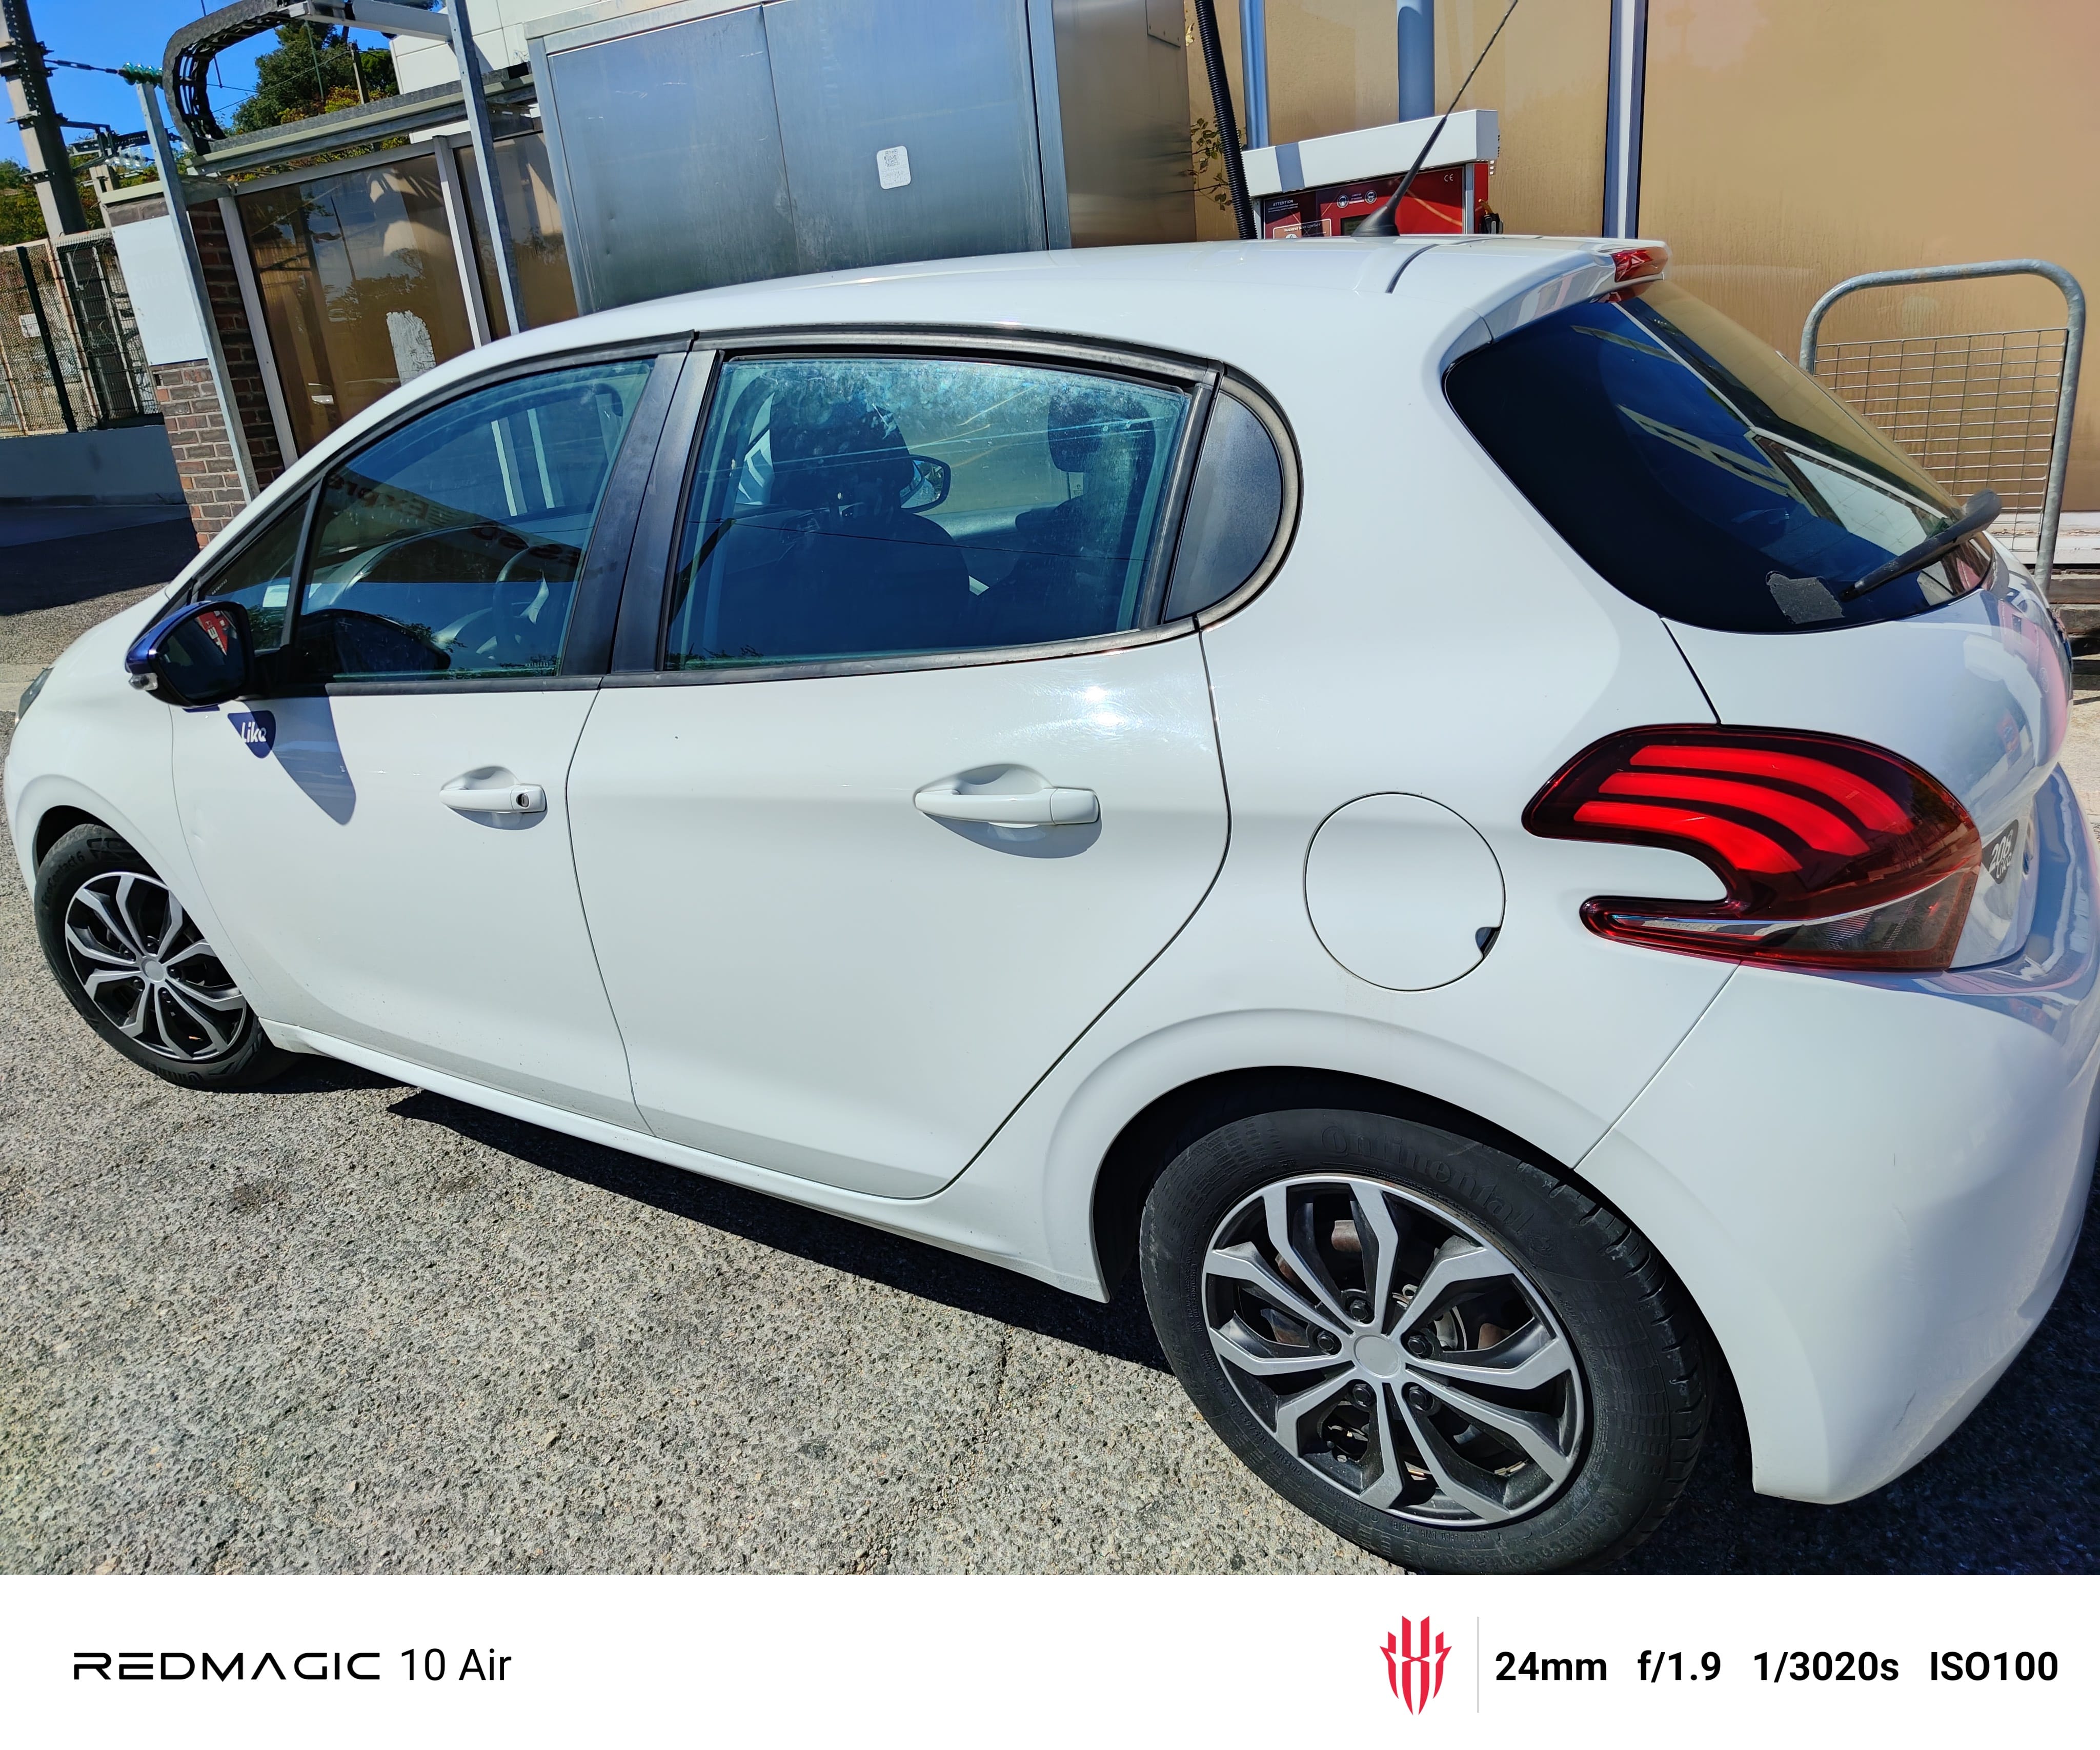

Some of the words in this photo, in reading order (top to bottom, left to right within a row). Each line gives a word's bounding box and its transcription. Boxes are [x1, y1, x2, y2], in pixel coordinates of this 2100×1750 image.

[241, 721, 267, 742] Like
[77, 850, 86, 862] 6
[1989, 829, 2013, 873] 208
[1321, 1125, 1535, 1235] Continental
